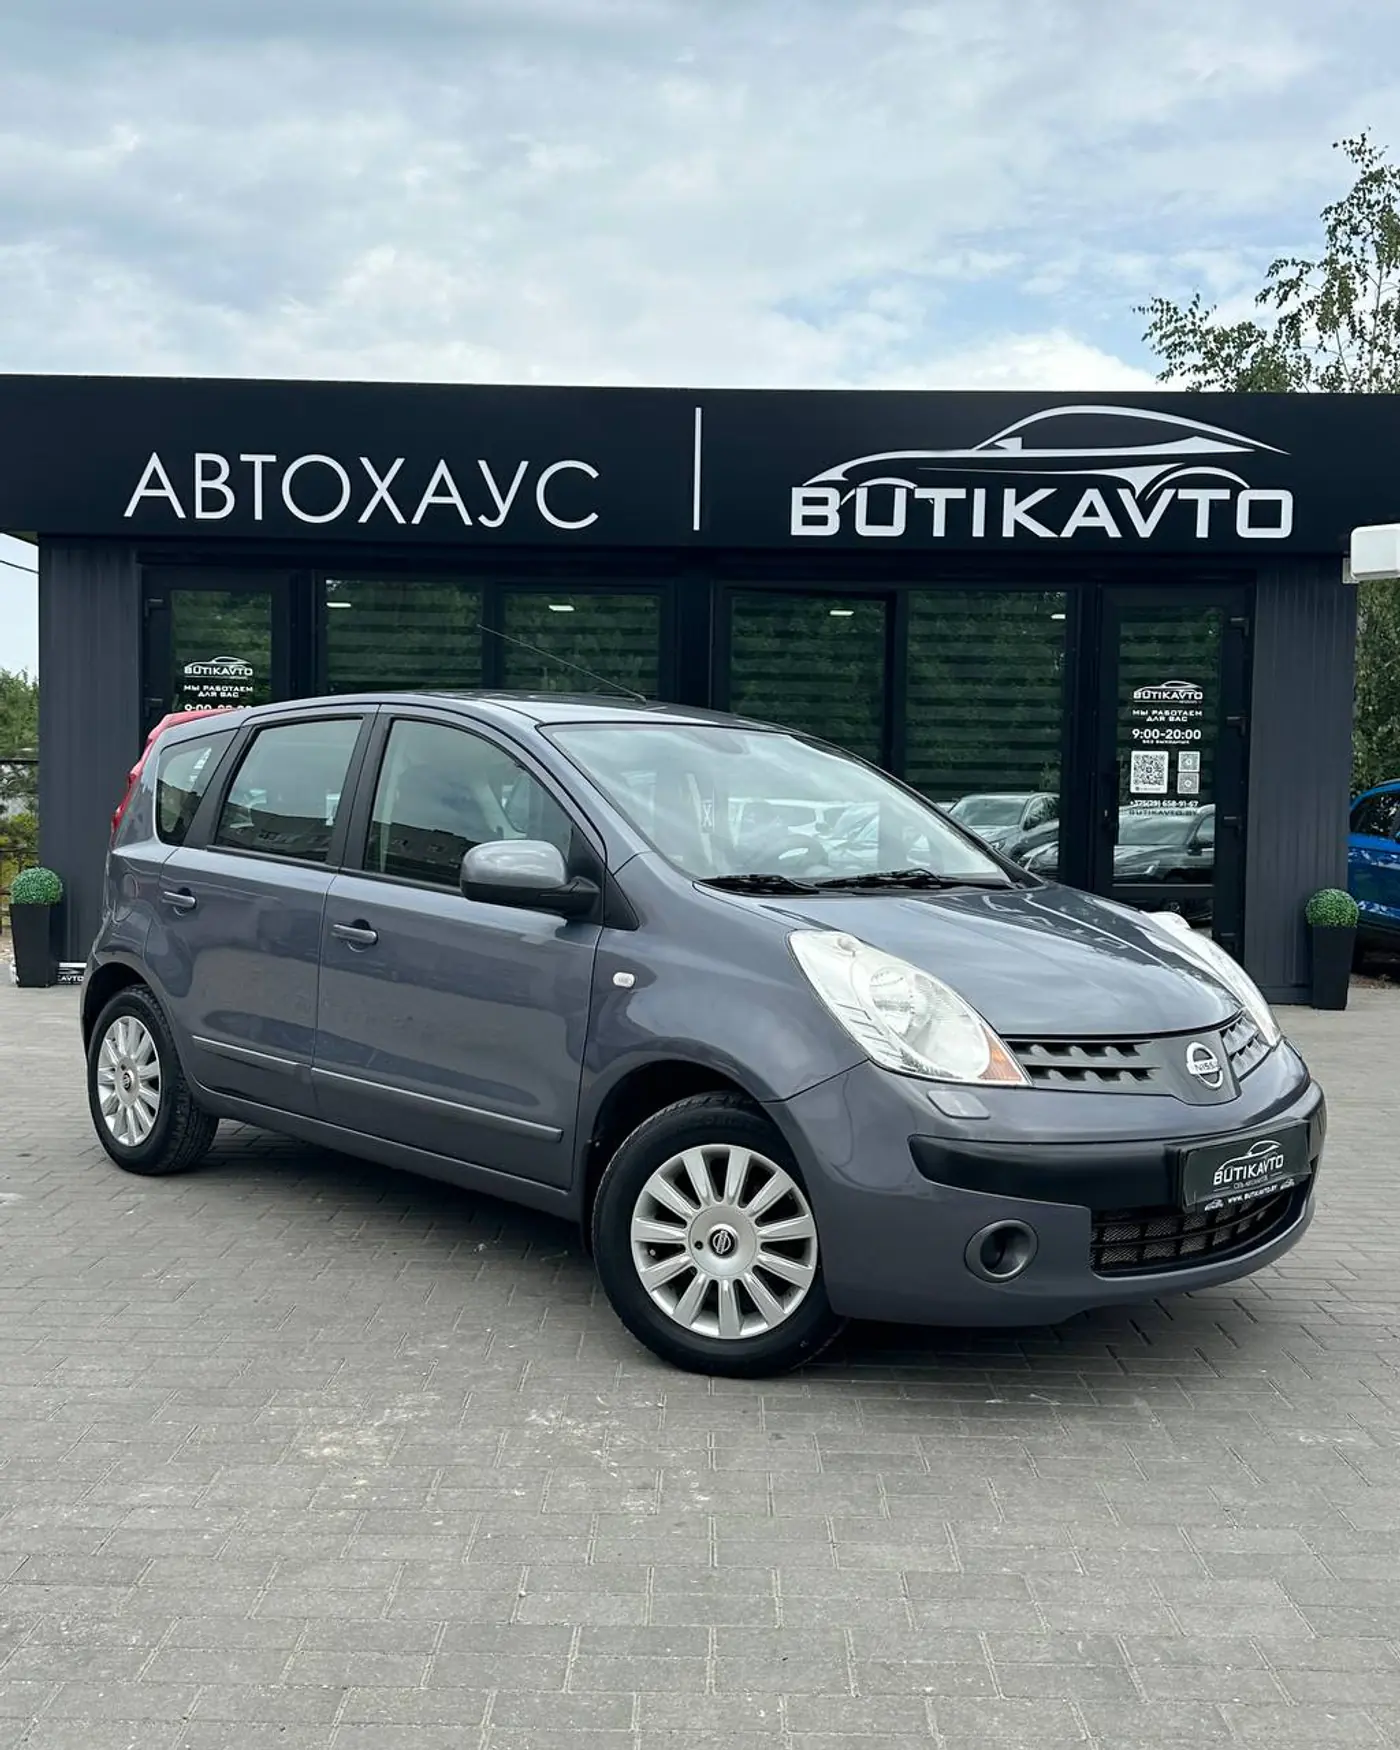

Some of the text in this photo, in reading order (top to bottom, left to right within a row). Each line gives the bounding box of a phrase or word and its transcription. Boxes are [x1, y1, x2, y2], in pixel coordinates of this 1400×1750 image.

[123, 451, 600, 530] АВТОХАУС
[790, 486, 1294, 539] BUTIKAVTO
[184, 665, 253, 676] BUTIKAVTO
[1133, 690, 1203, 700] BUTIKAVTO
[1152, 709, 1203, 717] РАБОТАЕМ
[1131, 728, 1202, 740] 9:00-20:00
[1213, 1154, 1284, 1186] BUTIKAVTO
